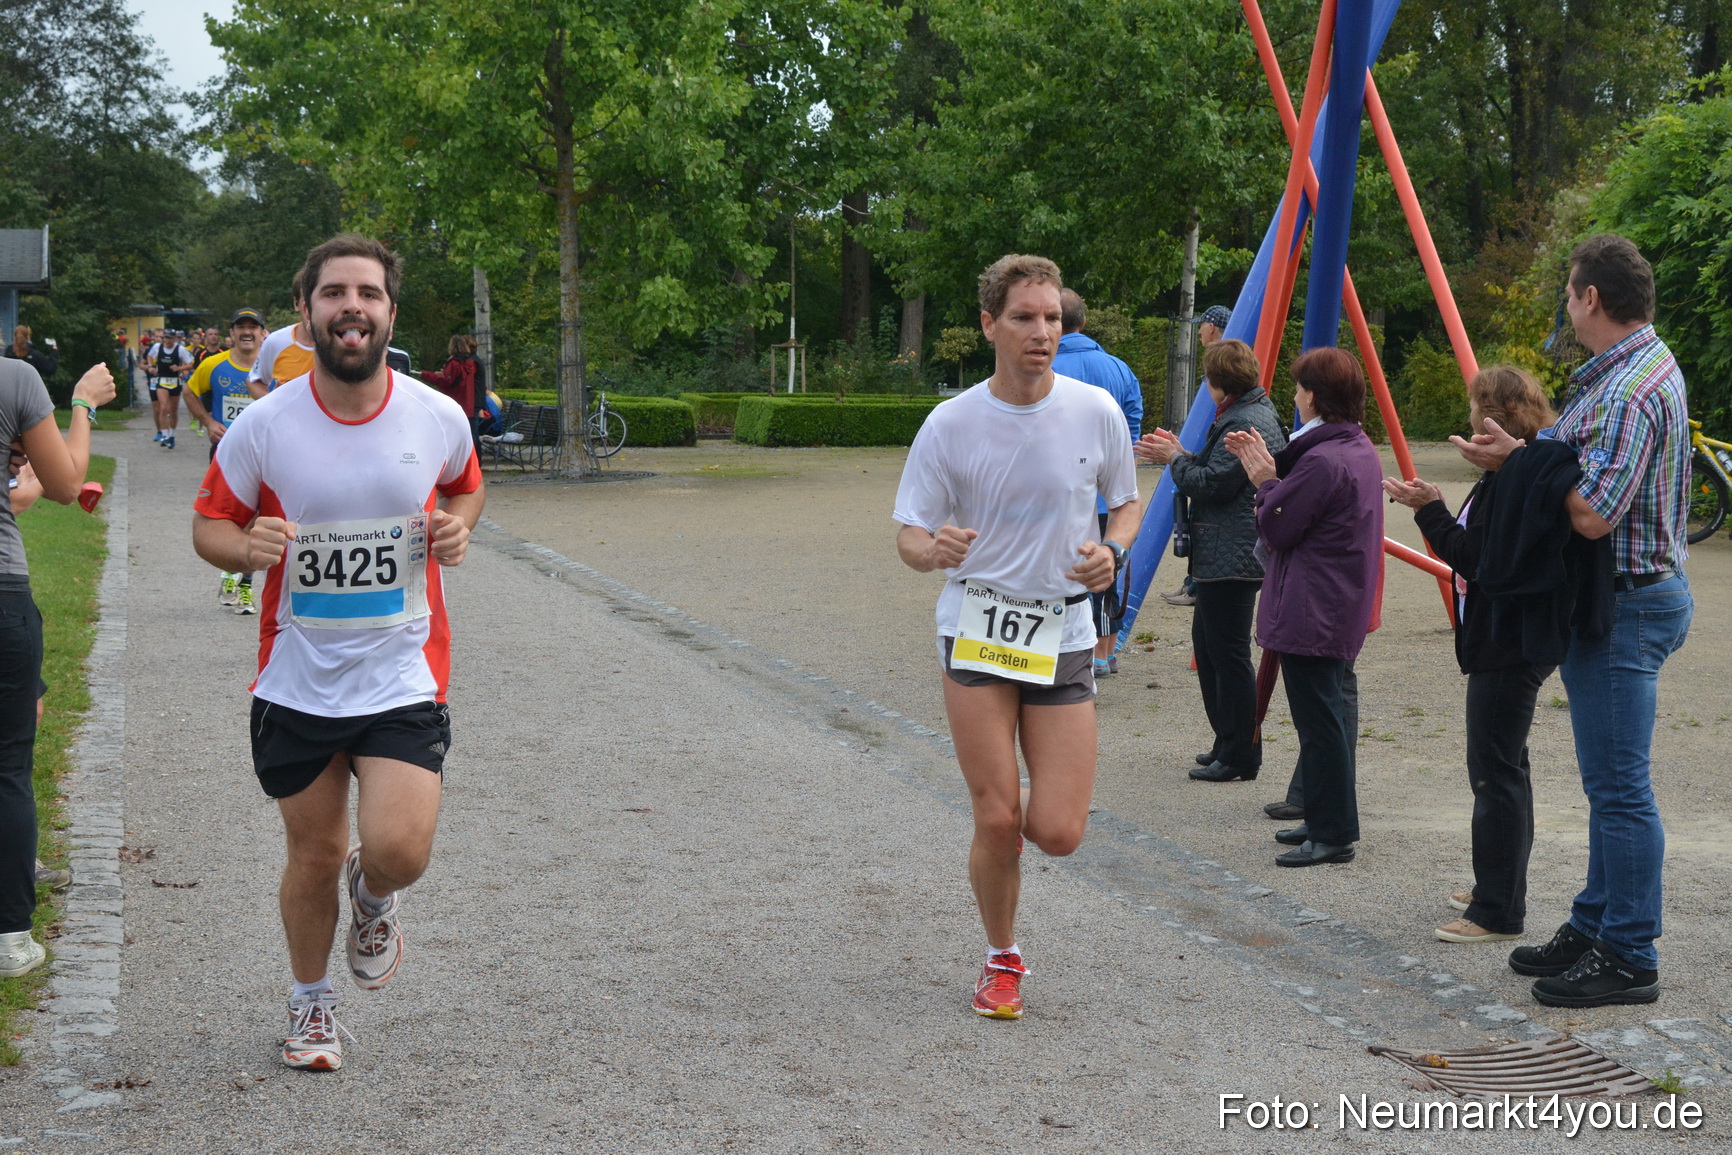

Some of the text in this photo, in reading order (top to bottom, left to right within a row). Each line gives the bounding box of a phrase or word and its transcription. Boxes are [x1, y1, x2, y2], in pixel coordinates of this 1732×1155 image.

[328, 529, 386, 543] Neumarkt
[297, 545, 397, 588] 3425
[966, 587, 1050, 612] PARTL Neumarkt
[983, 605, 1044, 647] 167
[979, 646, 1029, 669] Carsten
